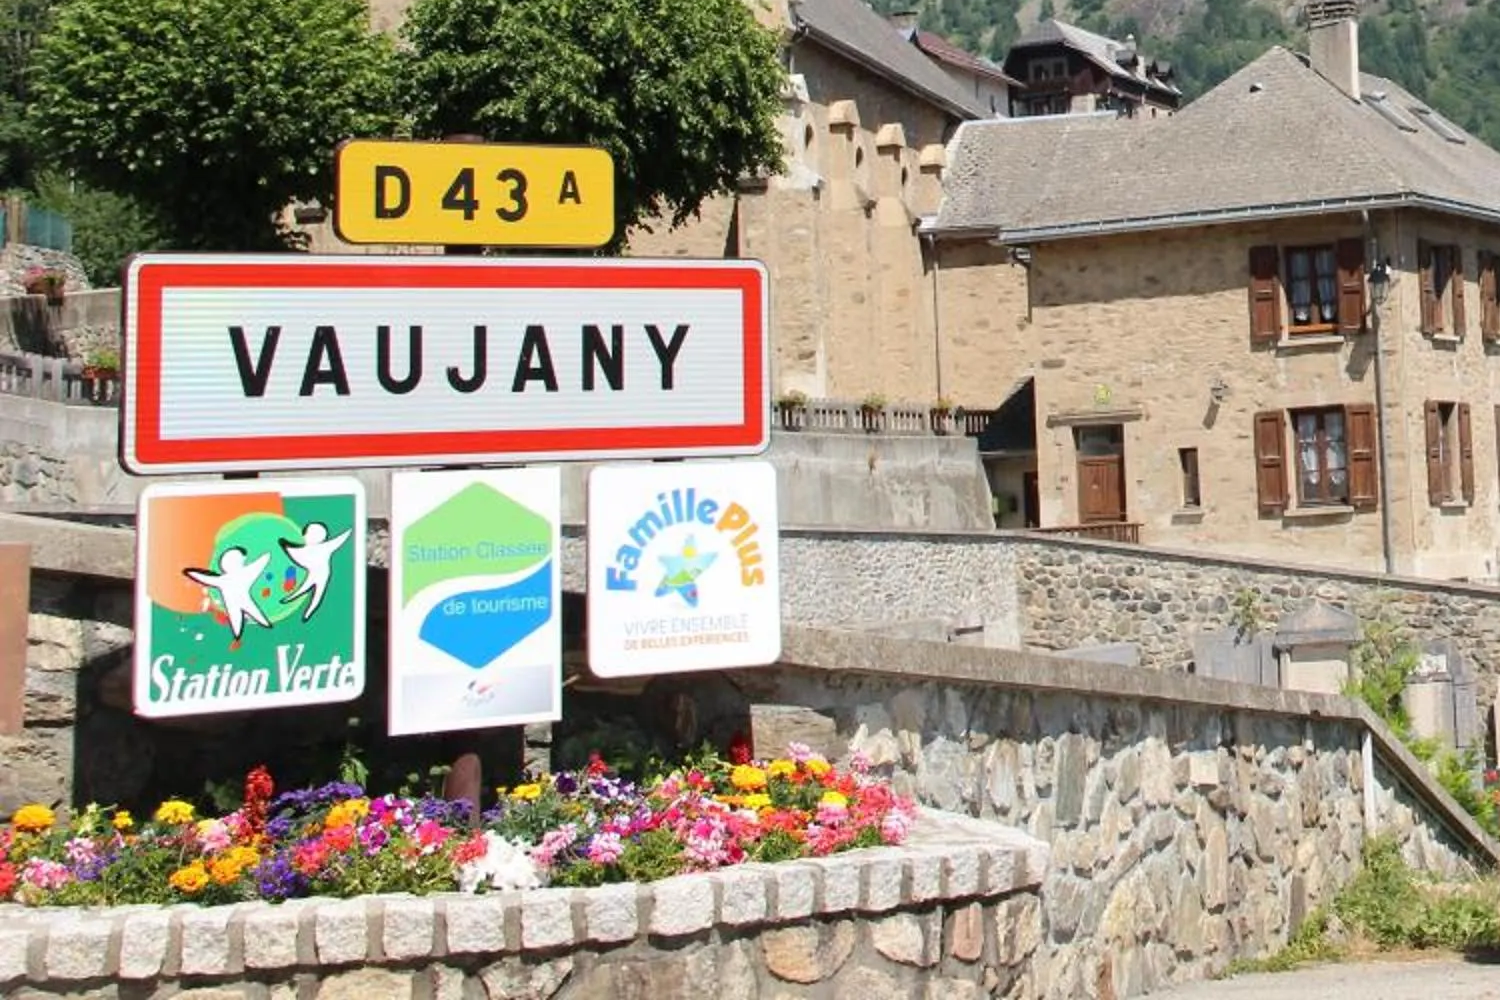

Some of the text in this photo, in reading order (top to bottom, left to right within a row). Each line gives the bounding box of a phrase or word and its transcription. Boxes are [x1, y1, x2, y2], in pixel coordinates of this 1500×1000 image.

[374, 165, 581, 222] D 43 A
[227, 324, 691, 397] VAUJANY
[408, 544, 470, 563] Station
[443, 596, 549, 616] de tourisme
[624, 613, 749, 636] VIVRE ENSEMBLE
[151, 643, 355, 703] Station Verte
